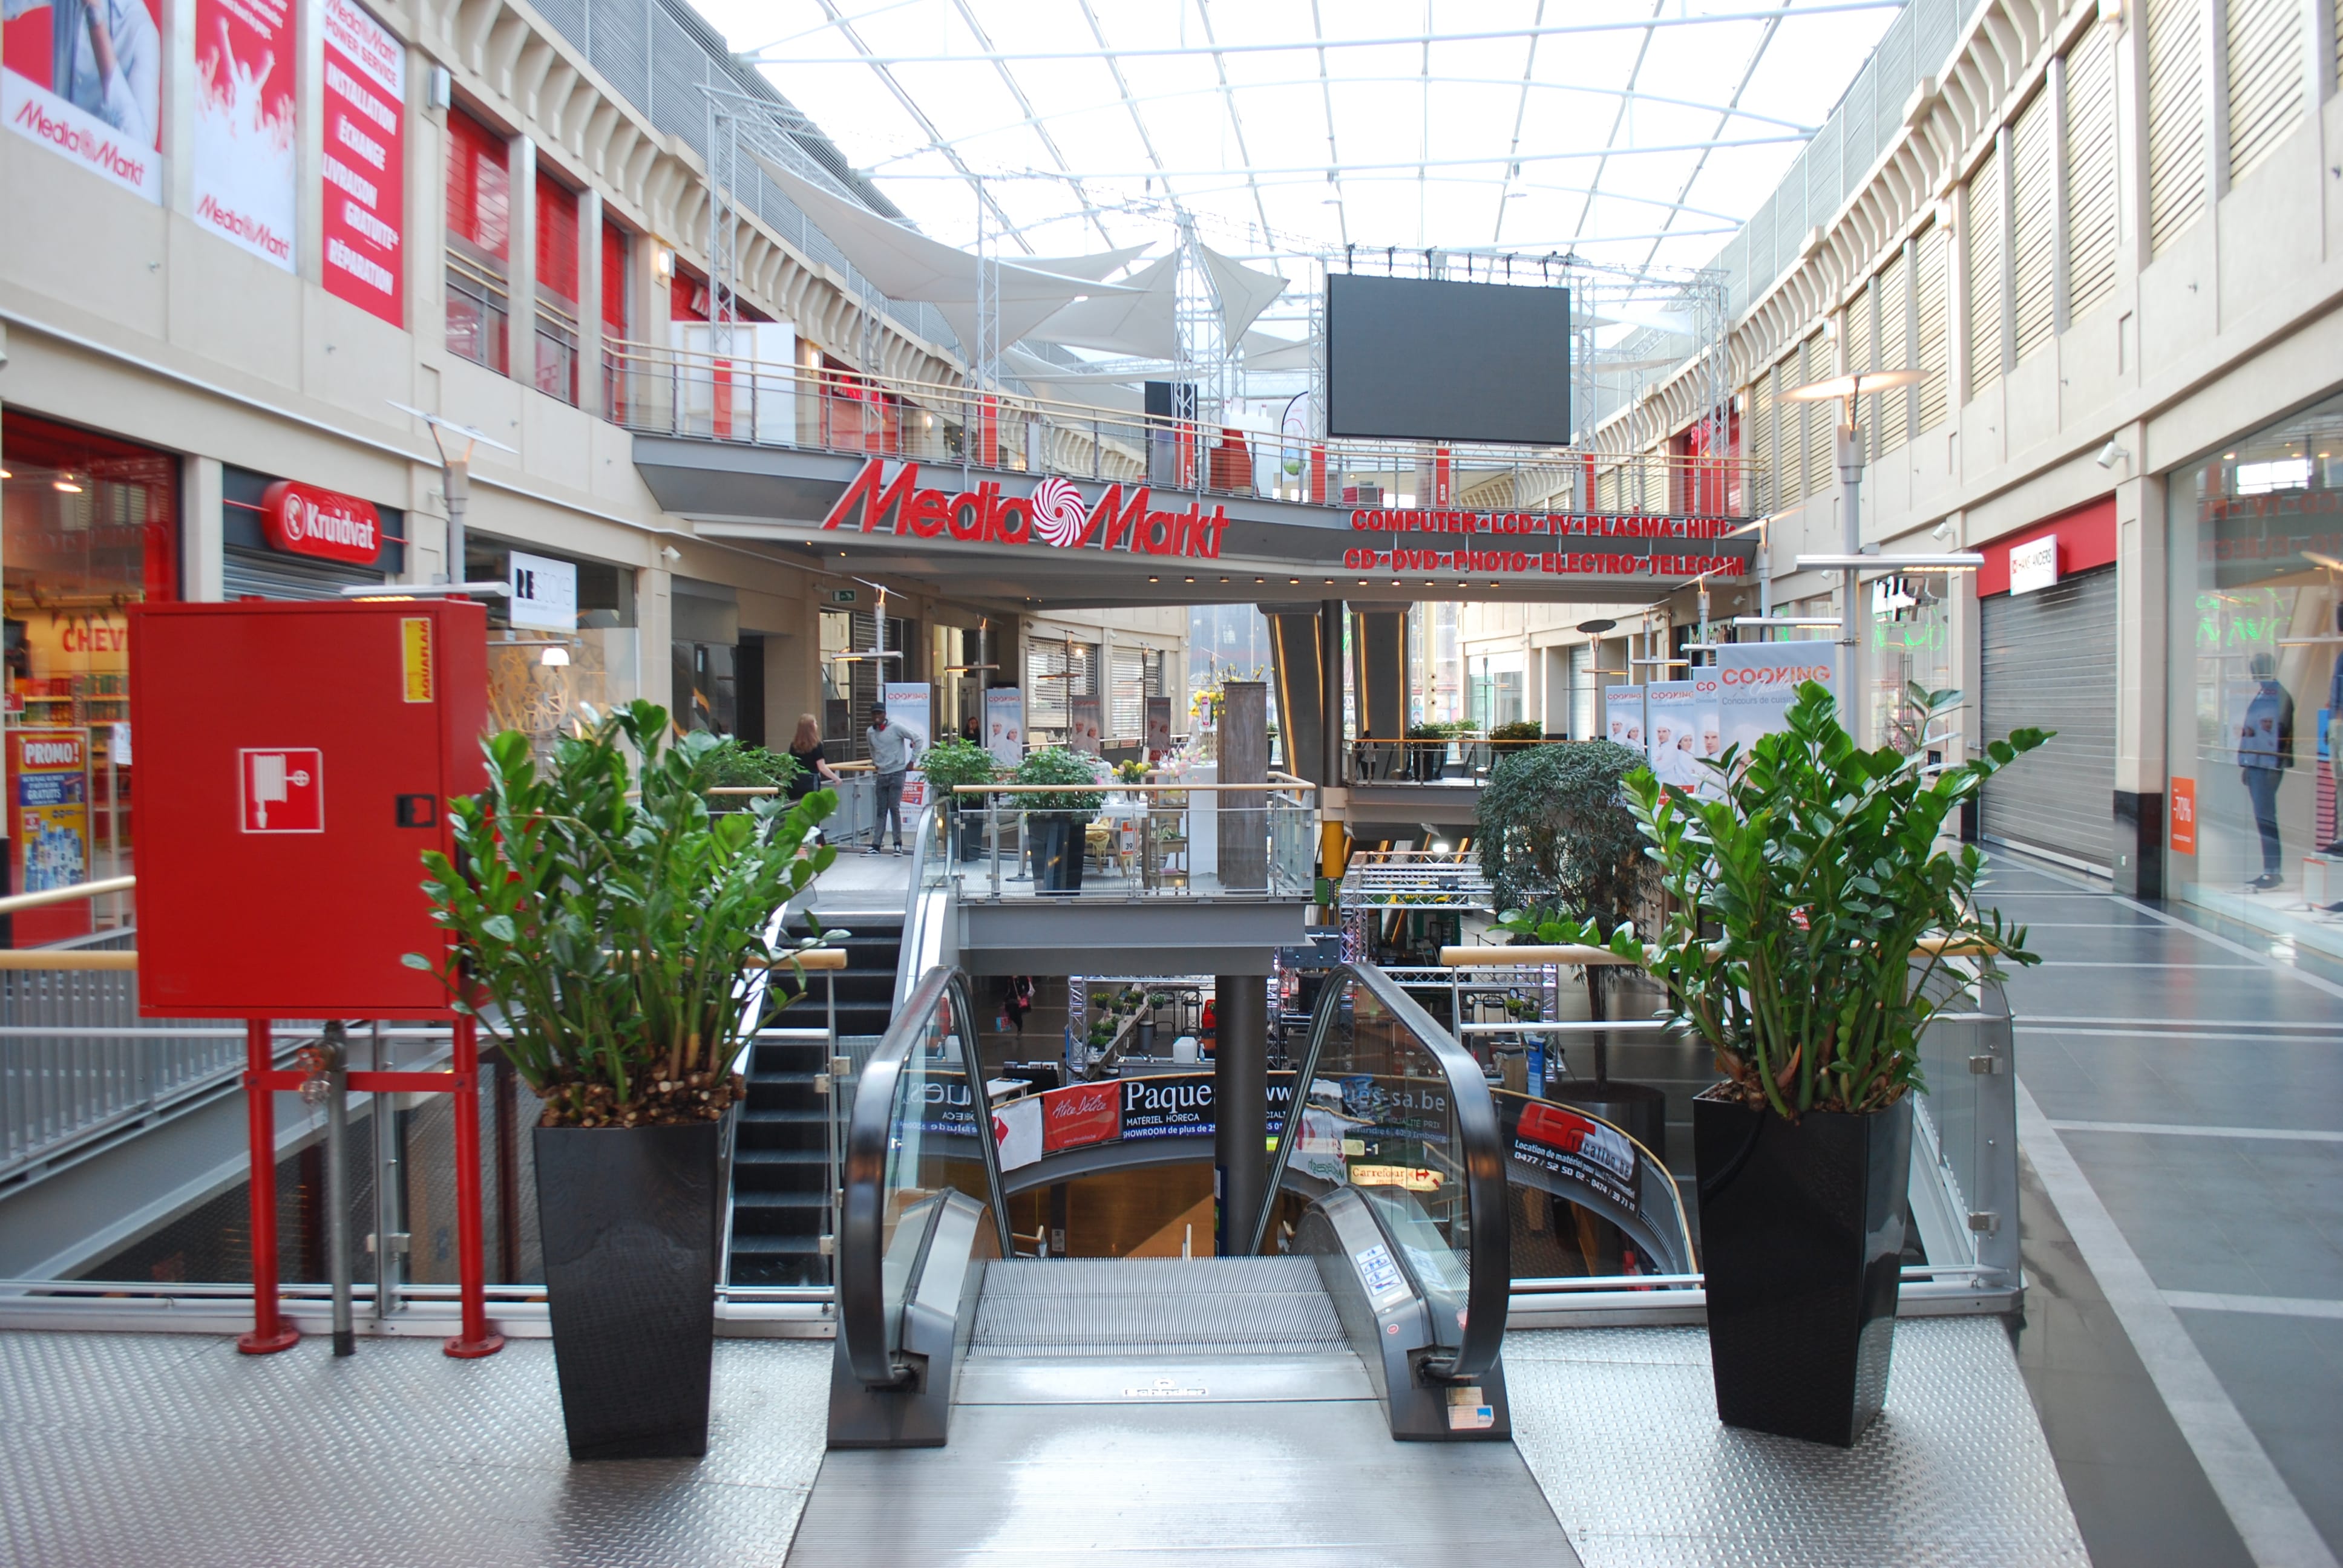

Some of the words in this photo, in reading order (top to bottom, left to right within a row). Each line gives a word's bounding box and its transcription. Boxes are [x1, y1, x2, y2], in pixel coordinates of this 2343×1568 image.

[326, 15, 359, 56] POWER
[362, 46, 398, 88] SERVICE
[326, 60, 397, 136] INSTALLATION
[15, 99, 81, 152] Media
[93, 140, 145, 186] Markt
[337, 114, 386, 171] ÉCHANGE
[323, 152, 378, 210] LIVRAISON
[197, 194, 243, 235] Media
[252, 229, 290, 261] Markt
[329, 238, 394, 295] RÉPARATION
[820, 459, 1030, 544] Media
[1072, 483, 1230, 558] Markt
[1351, 509, 1477, 534] COMPUTER
[1490, 513, 1533, 535] LCD
[1549, 515, 1573, 536] TV
[1585, 516, 1674, 538] PLASMA
[1685, 518, 1727, 539] HIFI
[304, 502, 375, 550] Kruidvat
[1344, 547, 1377, 570] CD
[1392, 549, 1438, 571] DVD
[1453, 550, 1527, 572] PHOTO
[1541, 552, 1634, 575] ELECTRO
[1650, 554, 1745, 577] TELECOM
[1722, 665, 1830, 685] COOKING
[1722, 696, 1757, 705] Concours
[1125, 1082, 1215, 1114] Paque
[1123, 1126, 1167, 1139] SHOWROOM
[1168, 1126, 1178, 1135] de
[1179, 1125, 1196, 1135] plus
[1197, 1124, 1207, 1133] de
[1126, 1116, 1163, 1126] MATÉRIEL
[1165, 1113, 1200, 1123] HORECA
[1366, 1143, 1379, 1155] -1
[1515, 1139, 1545, 1155] Location
[1545, 1149, 1555, 1158] de
[1555, 1154, 1583, 1169] matériel
[1352, 1168, 1404, 1178] Carrefour
[1514, 1151, 1538, 1165] 0477
[1546, 1161, 1559, 1172] 52
[1575, 1171, 1585, 1181] 02
